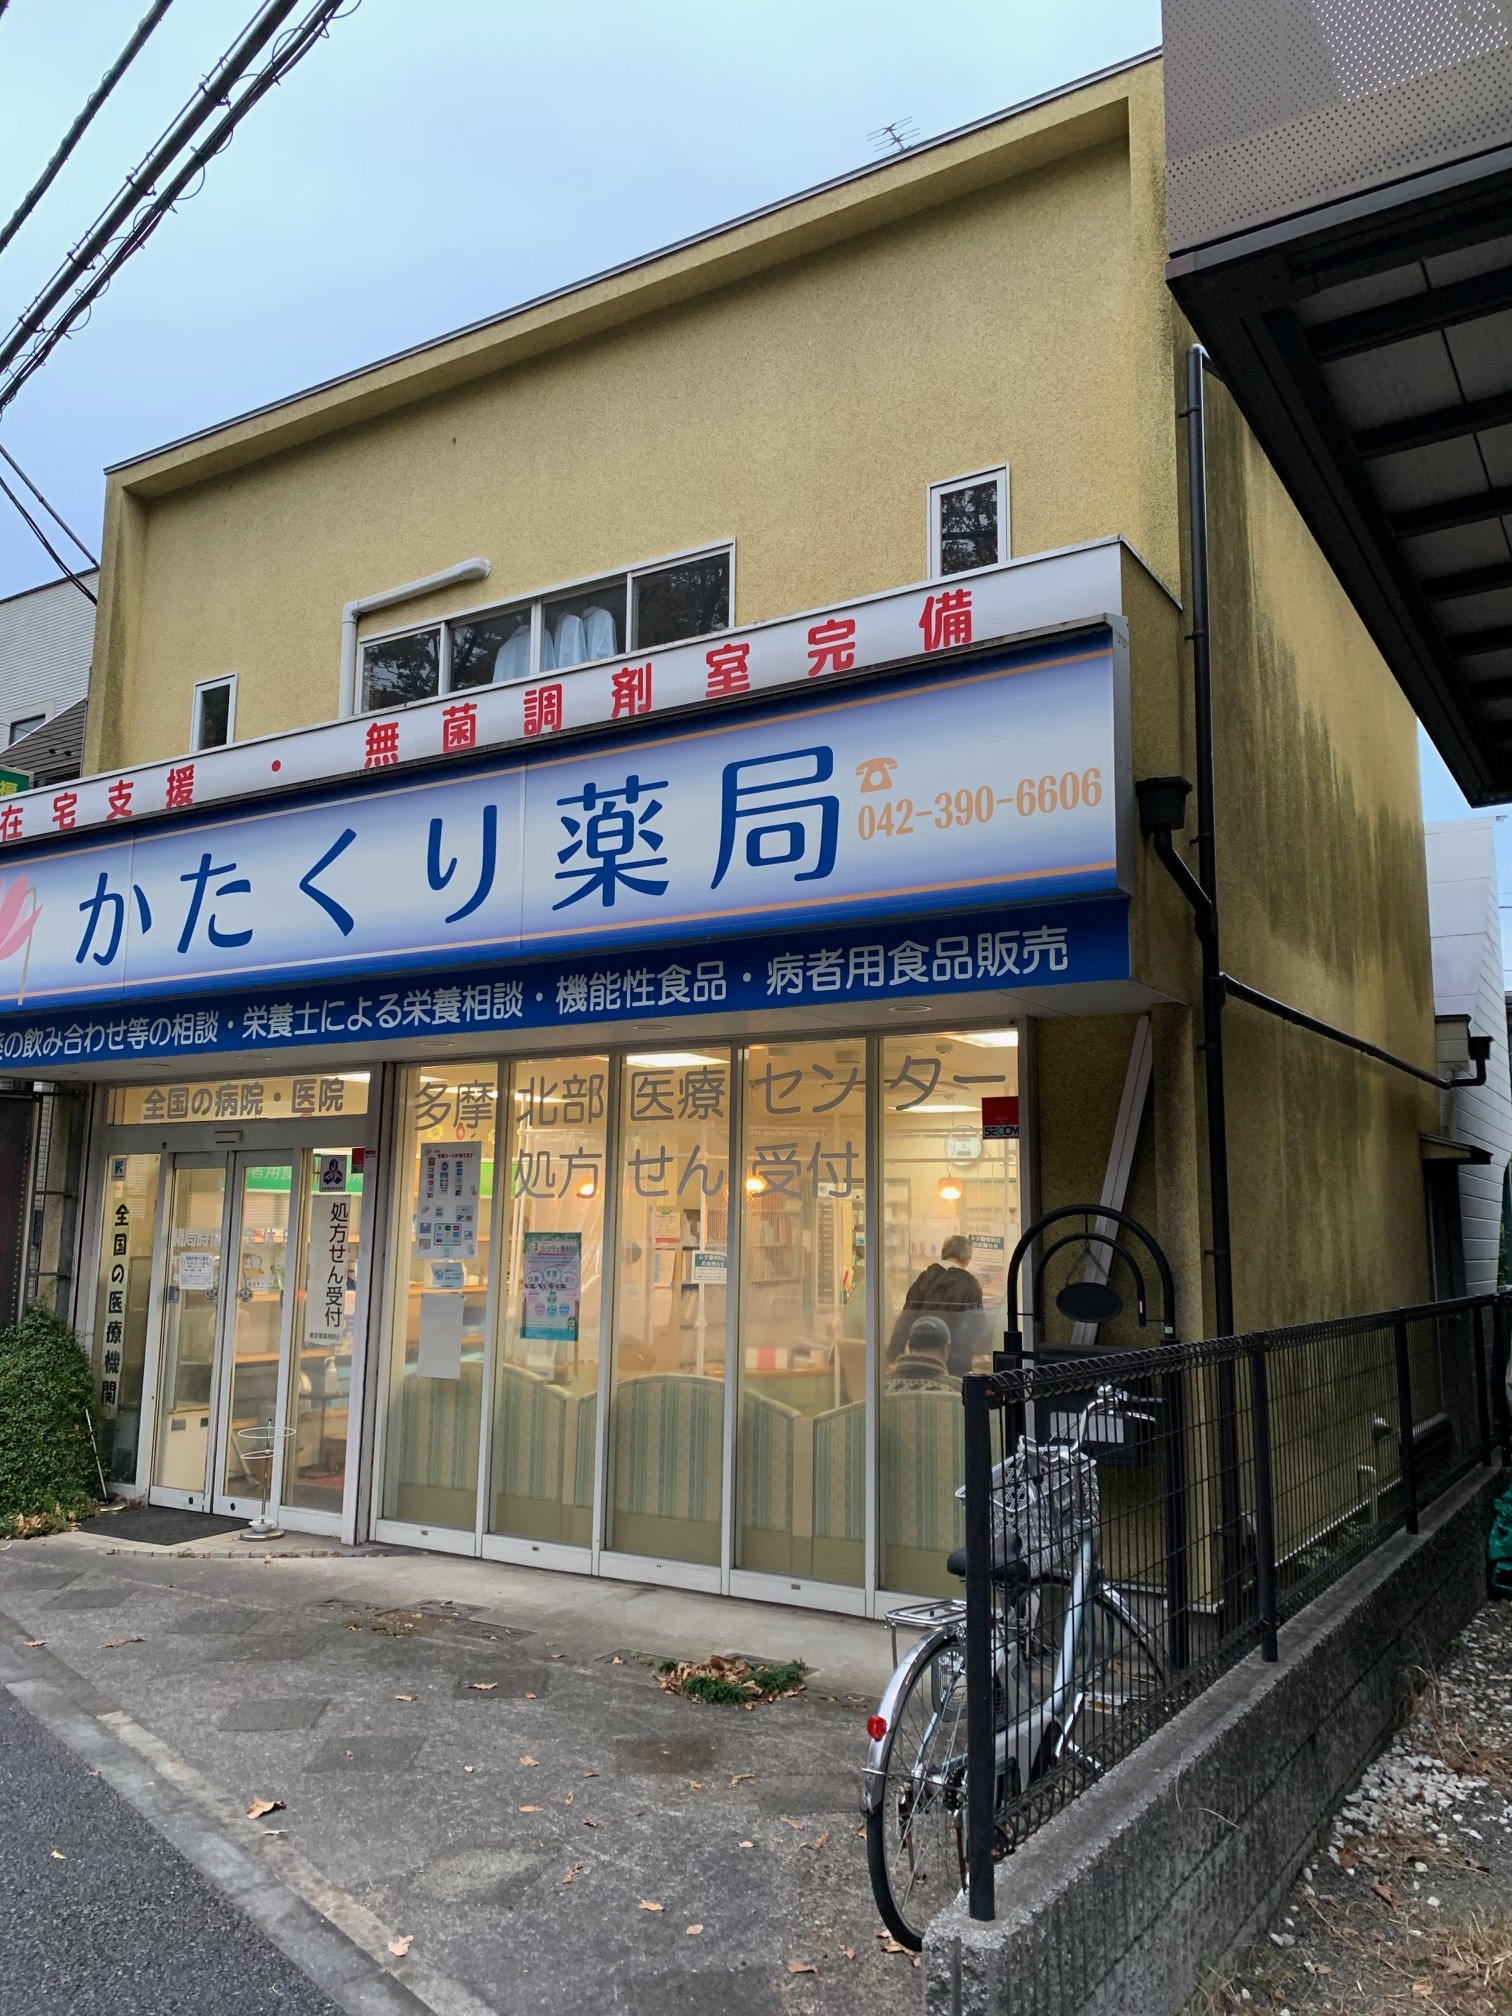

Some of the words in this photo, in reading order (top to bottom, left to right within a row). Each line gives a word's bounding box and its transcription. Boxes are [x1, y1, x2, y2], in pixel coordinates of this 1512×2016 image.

[0, 589, 973, 843] 在宅支援・無菌調剤室完備
[76, 746, 839, 966] かたくり薬局
[857, 768, 1103, 841] 042-390-6606
[0, 926, 1068, 1061] の飲み合わせ等の相談・栄養士による栄養相談・機能性食品・病者用食品販売
[143, 1077, 345, 1121] 全国の病院・医院
[101, 1204, 130, 1405] 全国の医療機関
[325, 1202, 349, 1328] 処方せん受付
